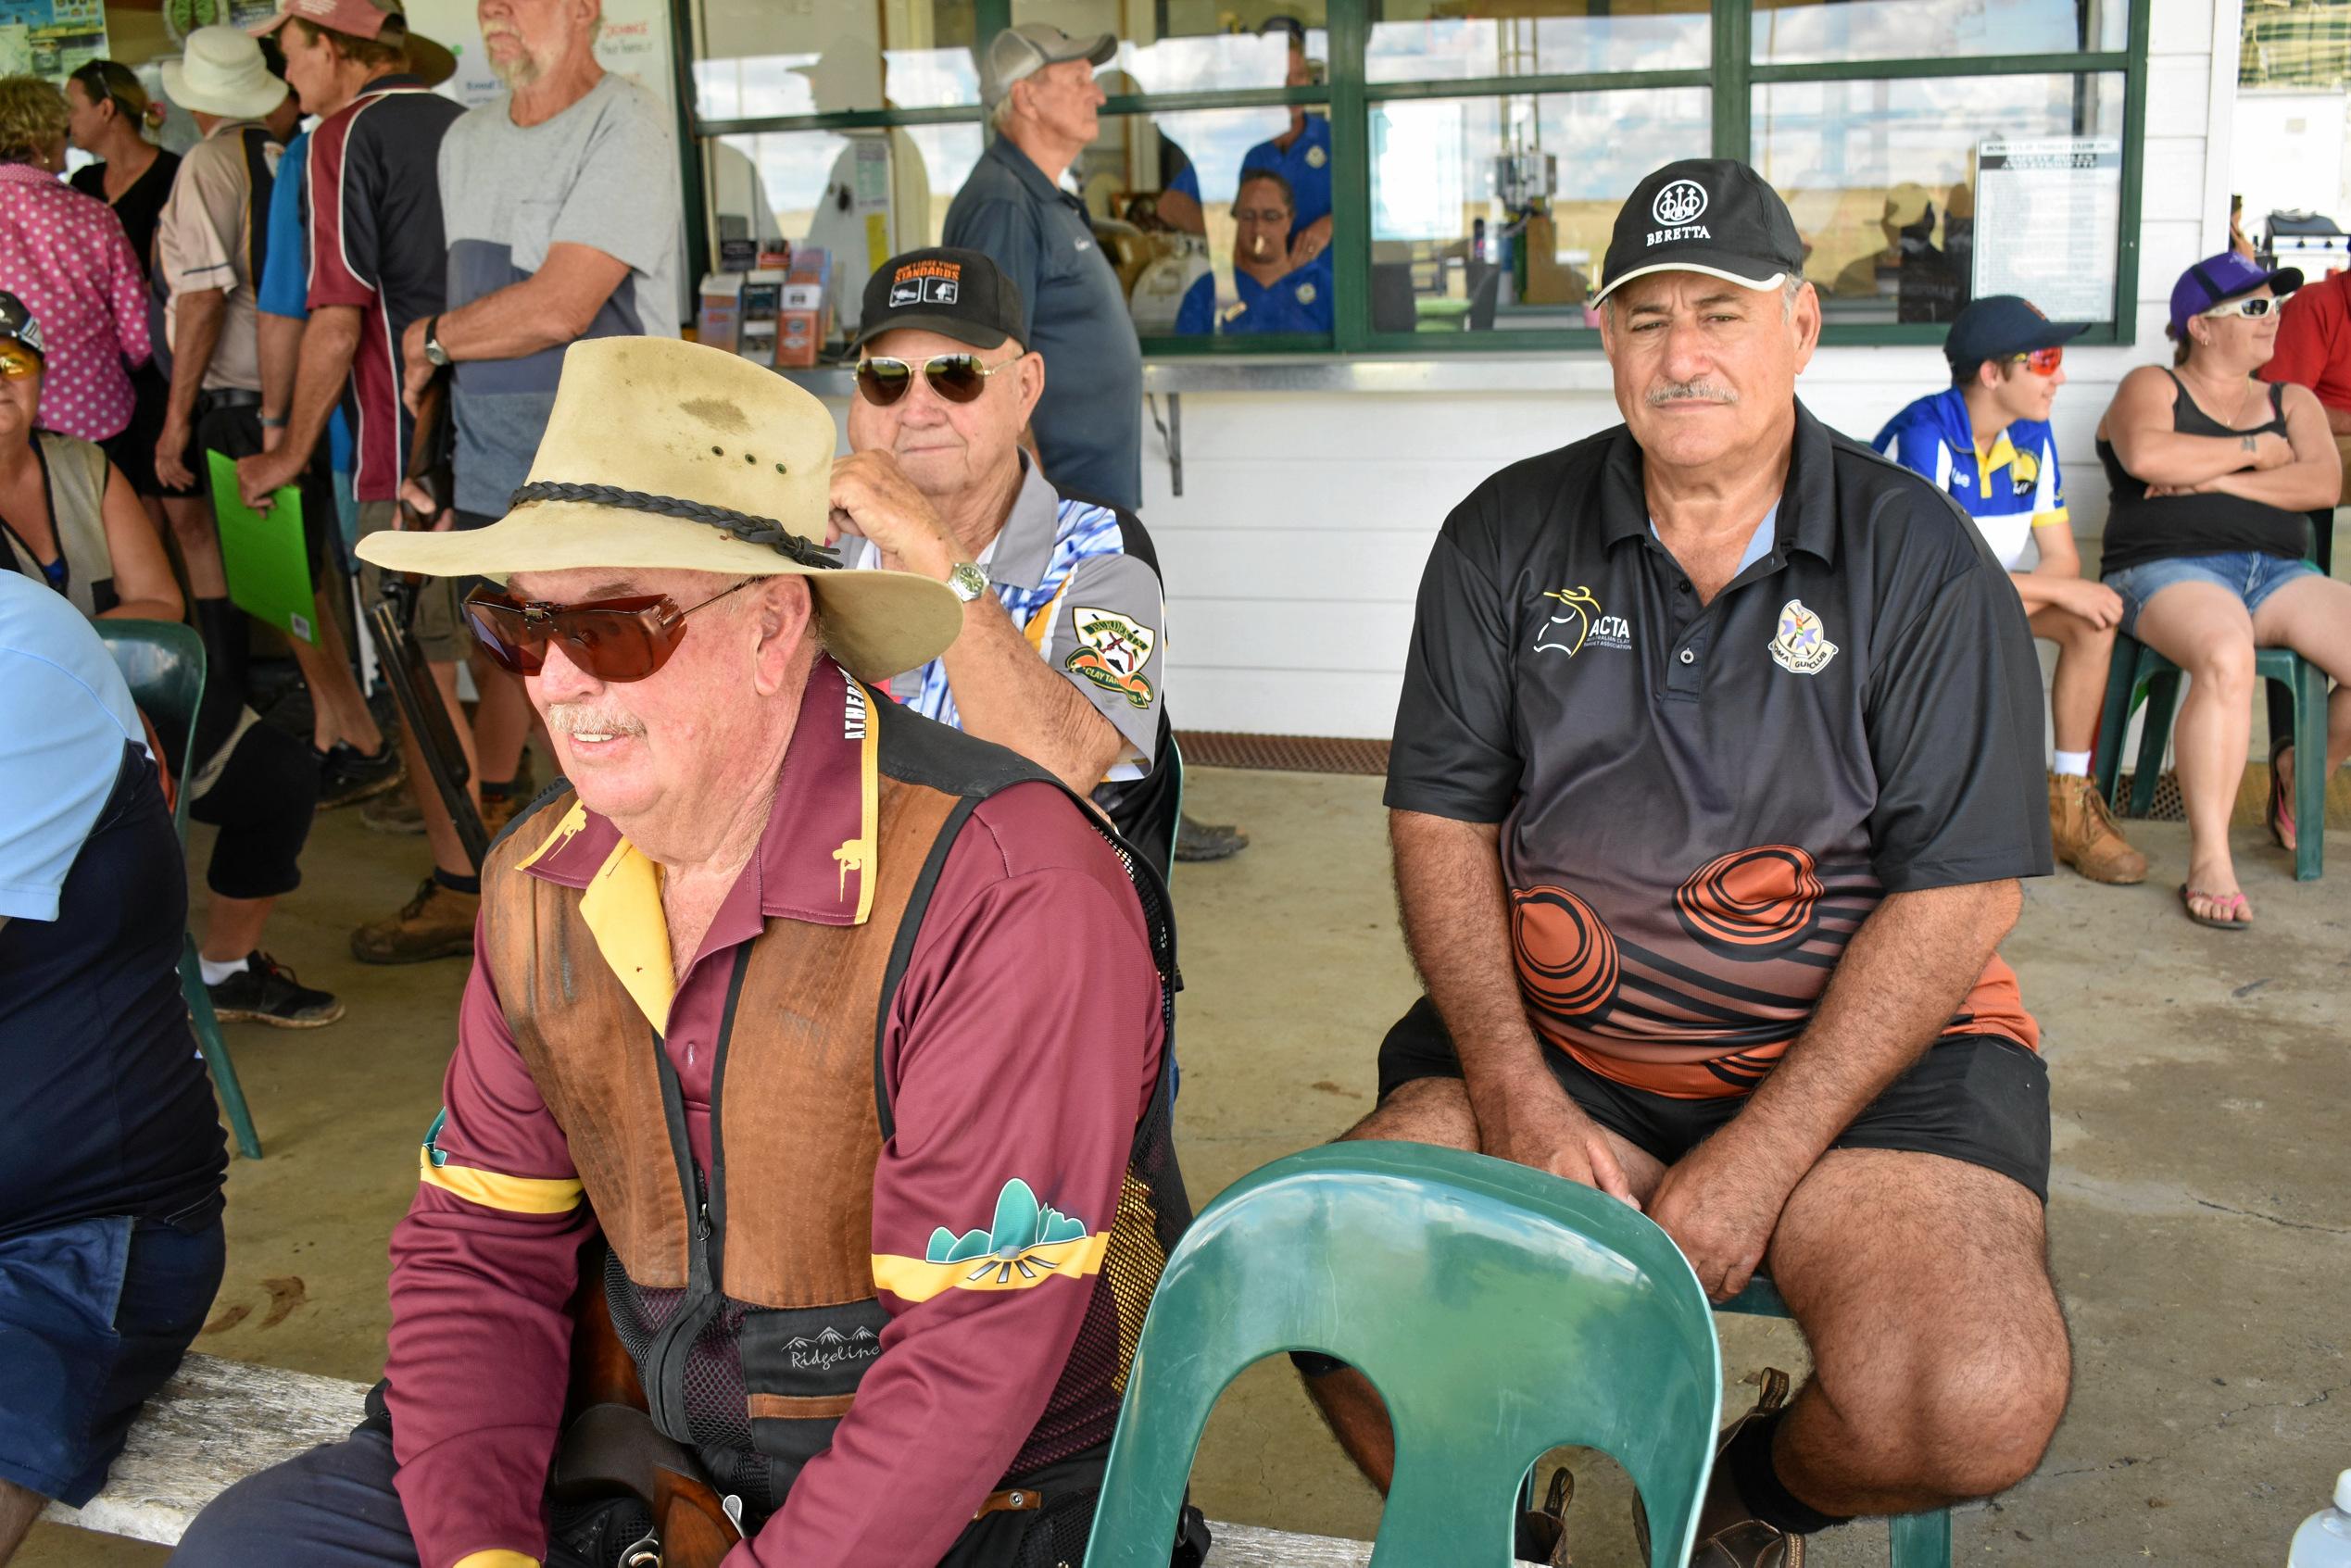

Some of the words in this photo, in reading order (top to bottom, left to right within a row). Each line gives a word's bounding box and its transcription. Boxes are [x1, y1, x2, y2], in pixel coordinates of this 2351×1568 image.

[1646, 225, 1712, 247] BERETTA
[893, 266, 959, 284] STANDARDS
[1090, 621, 1142, 646] BURDEKIN
[1589, 616, 1630, 638] ACTA
[1809, 650, 1827, 669] CLUB
[1085, 667, 1105, 681] CLAY
[791, 1345, 881, 1371] Ridgeline
